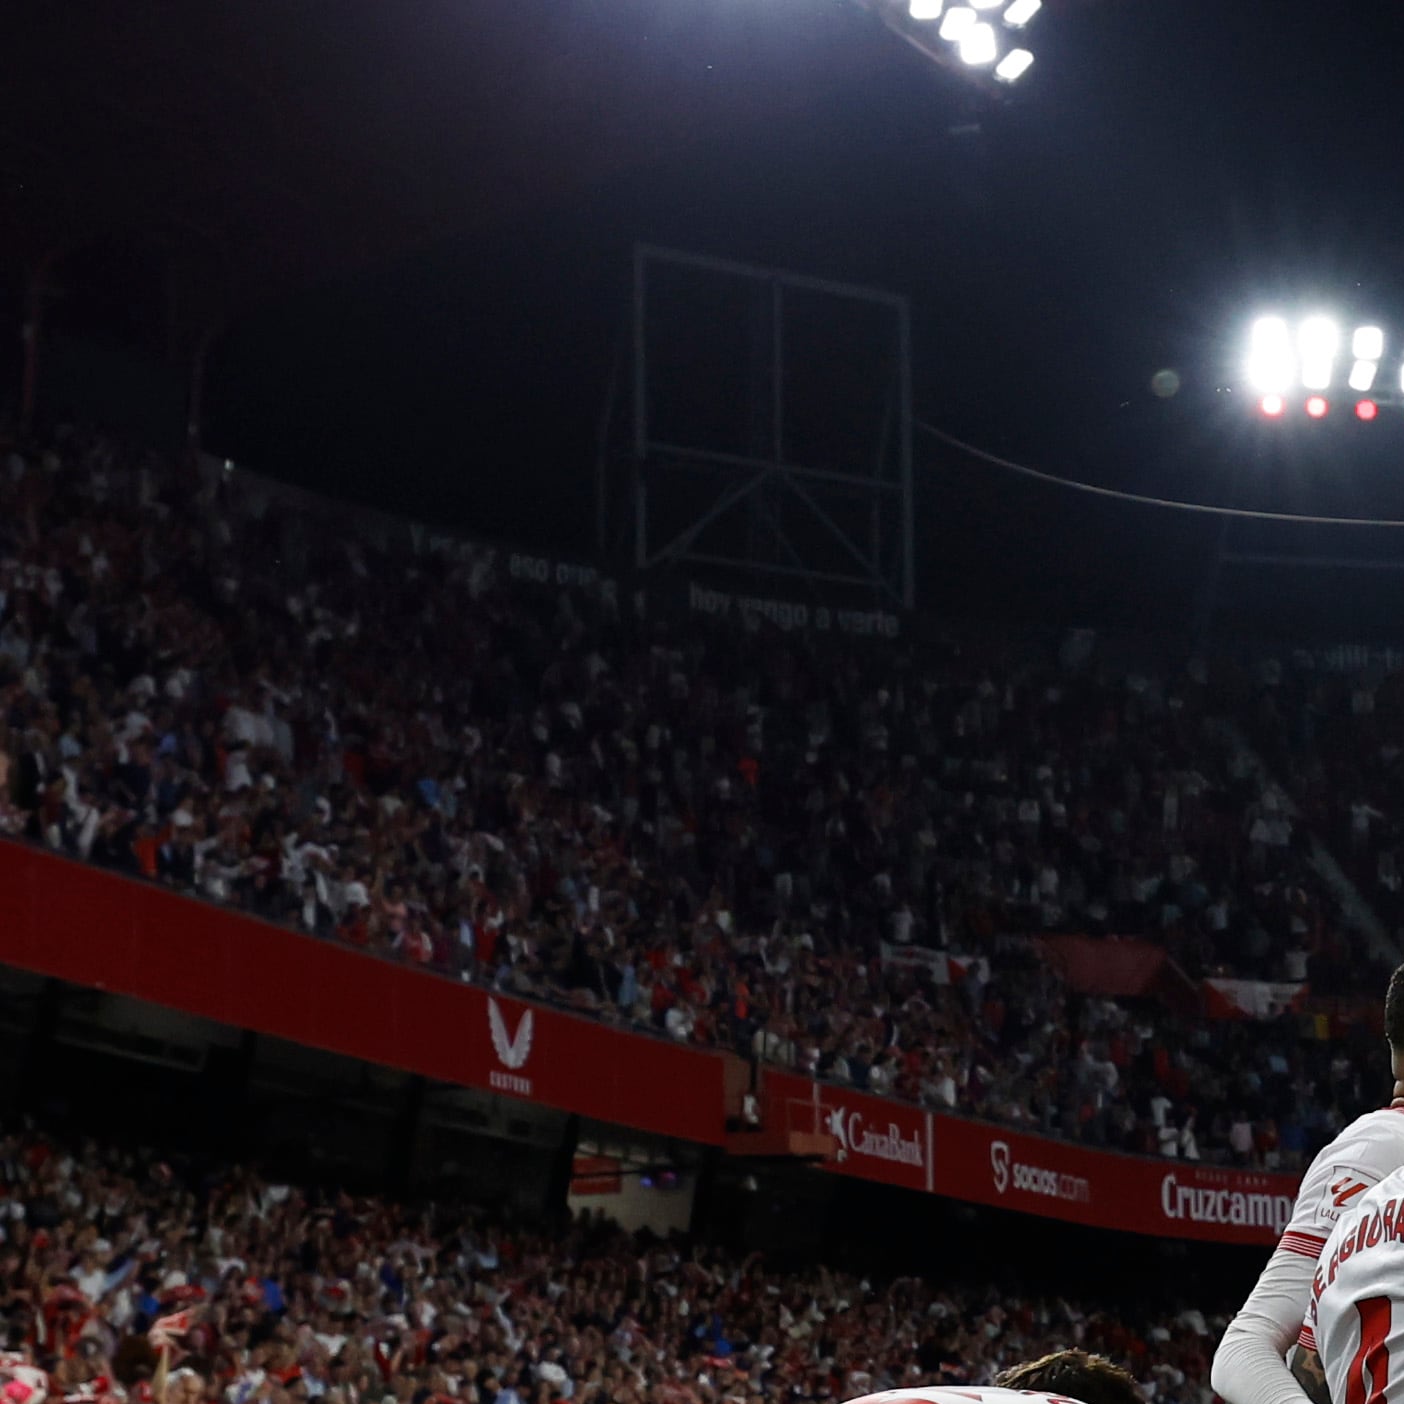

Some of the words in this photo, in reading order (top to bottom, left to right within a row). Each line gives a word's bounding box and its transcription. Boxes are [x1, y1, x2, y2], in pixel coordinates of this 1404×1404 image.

[848, 1112, 923, 1166] CaixaBank
[1161, 1171, 1296, 1237] Cruzcamp
[1320, 1207, 1340, 1222] LALI
